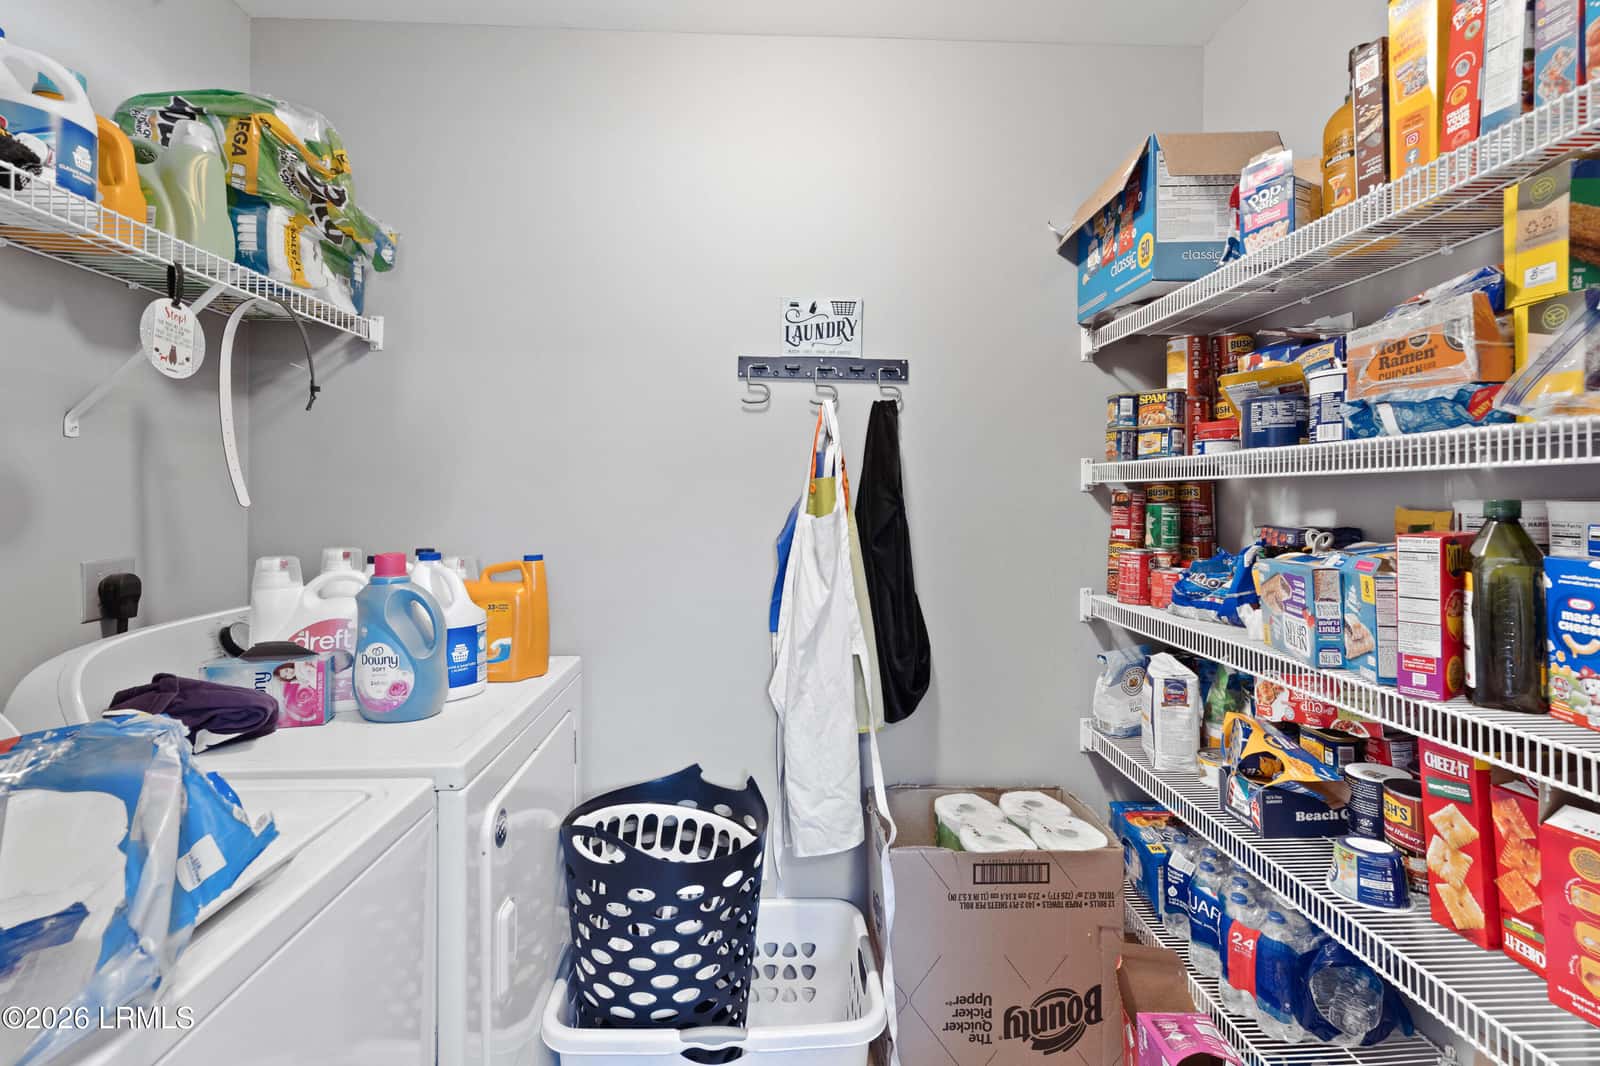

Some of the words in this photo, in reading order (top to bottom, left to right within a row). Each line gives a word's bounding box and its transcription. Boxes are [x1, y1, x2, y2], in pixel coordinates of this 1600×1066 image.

[1182, 249, 1221, 260] classic
[785, 317, 858, 347] LAUNDRY
[1378, 348, 1436, 370] Ramen
[1139, 393, 1167, 405] SPAM
[294, 630, 352, 650] dreft
[361, 654, 399, 669] Downy
[1295, 811, 1339, 822] Beach
[1231, 932, 1255, 951] 24
[956, 993, 992, 1005] Upper
[952, 1009, 992, 1020] Picker
[1003, 984, 1103, 1045] Bounty
[943, 1020, 993, 1032] Quicker
[968, 1033, 992, 1045] The
